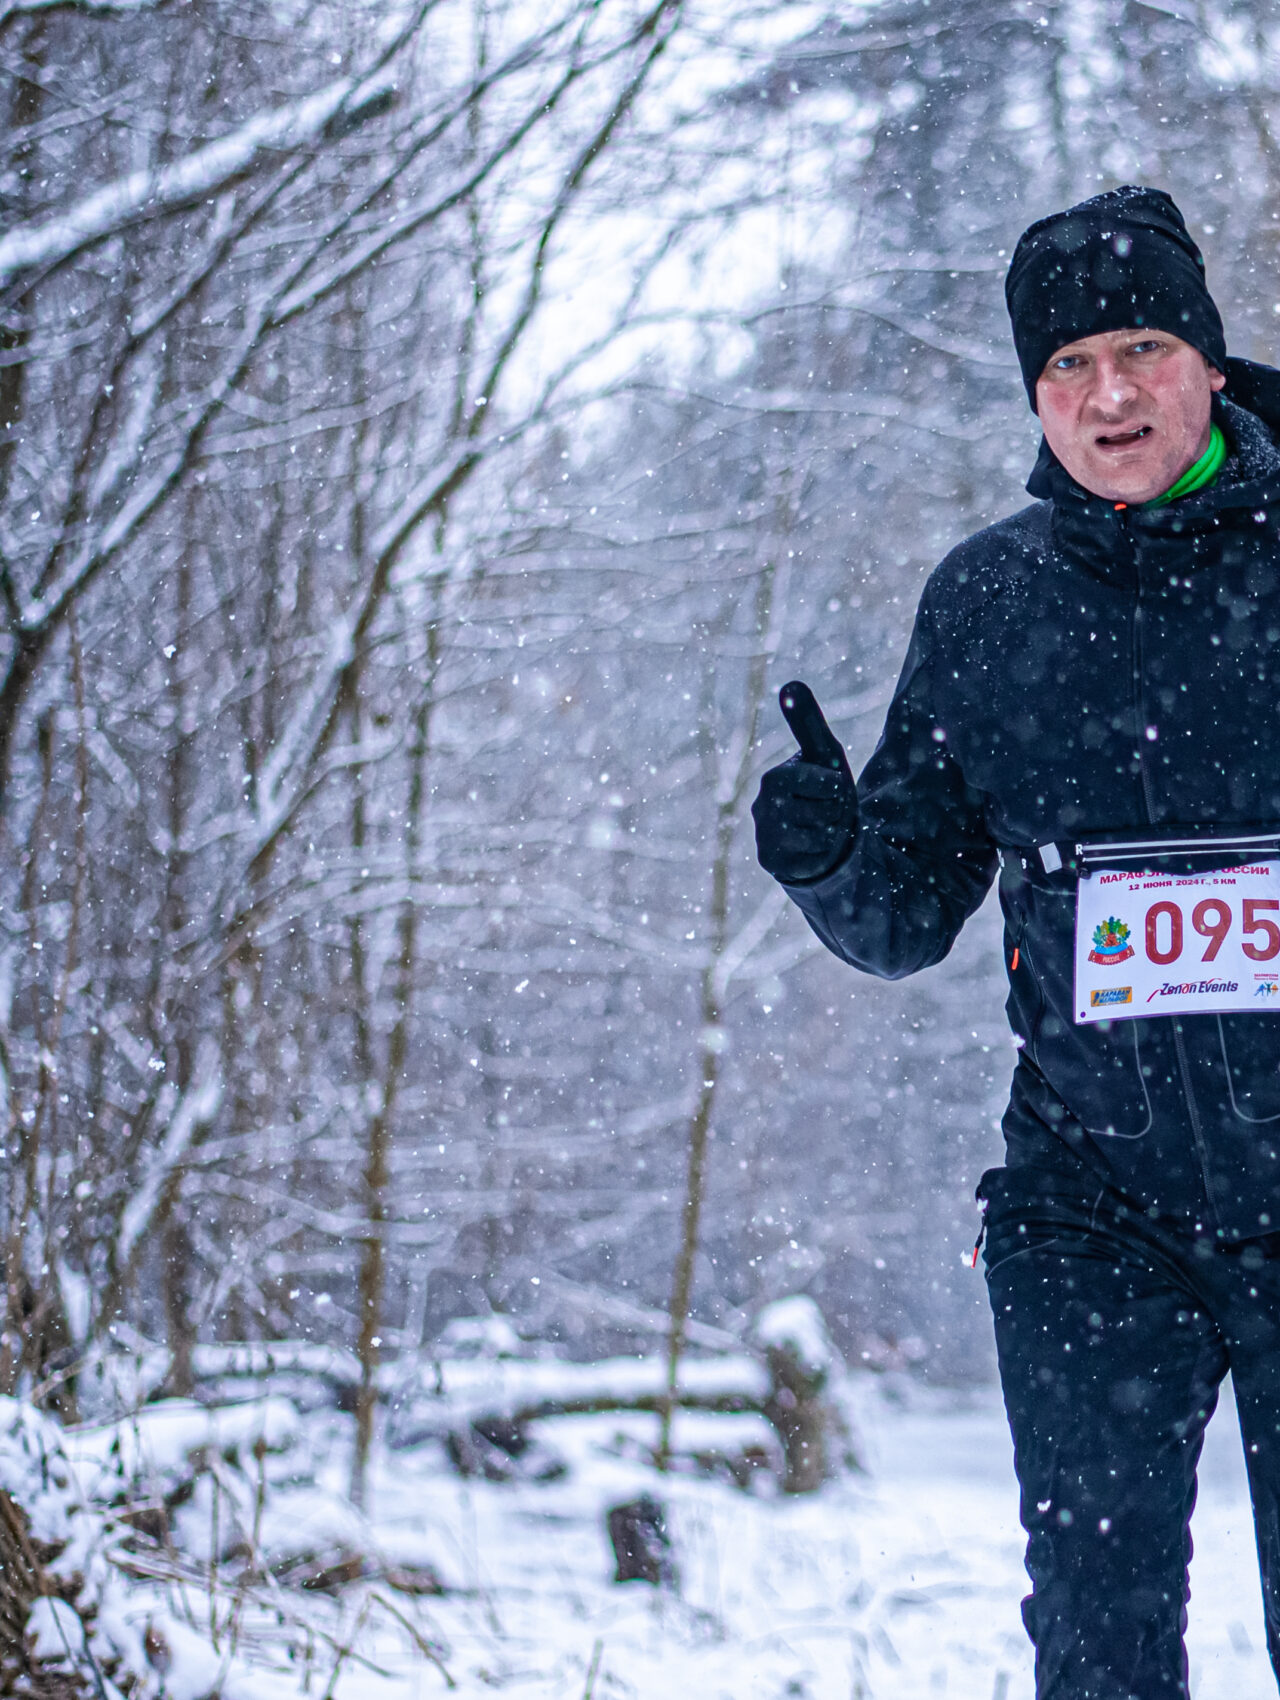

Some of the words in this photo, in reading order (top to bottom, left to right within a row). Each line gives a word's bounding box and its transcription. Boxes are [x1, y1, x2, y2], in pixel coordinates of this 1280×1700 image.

[1128, 883, 1140, 891] 12
[1143, 880, 1173, 889] ИЮНЯ
[1175, 878, 1200, 886] 2024
[1159, 982, 1198, 996] Zenon
[1197, 980, 1239, 993] Events
